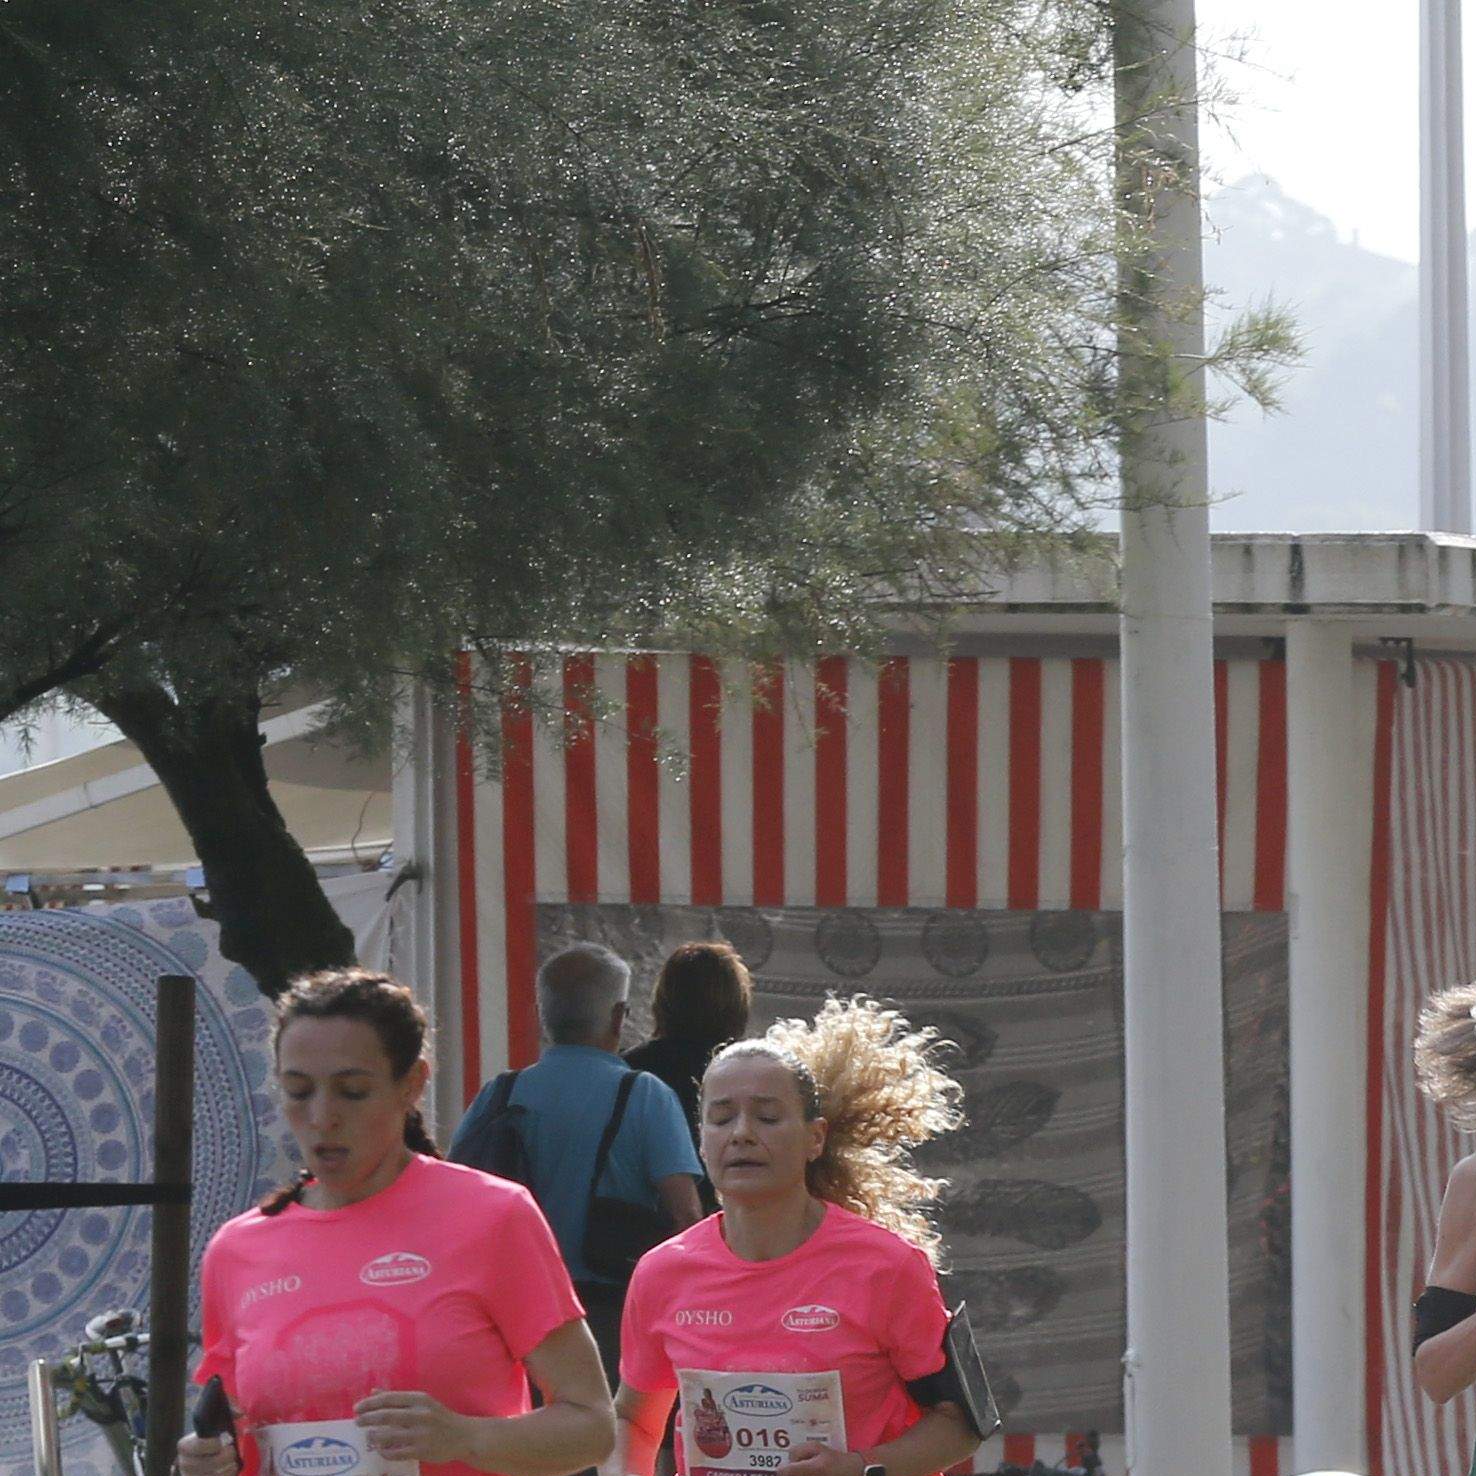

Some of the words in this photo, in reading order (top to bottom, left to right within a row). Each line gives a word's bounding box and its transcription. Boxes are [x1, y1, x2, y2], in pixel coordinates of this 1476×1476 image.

[675, 1310, 733, 1326] OYSHO
[786, 1315, 835, 1326] ASTURIANA
[730, 1396, 788, 1410] ASTURIANA
[797, 1392, 830, 1402] SUMA
[736, 1427, 790, 1448] 016
[285, 1453, 354, 1469] ASTURIANA
